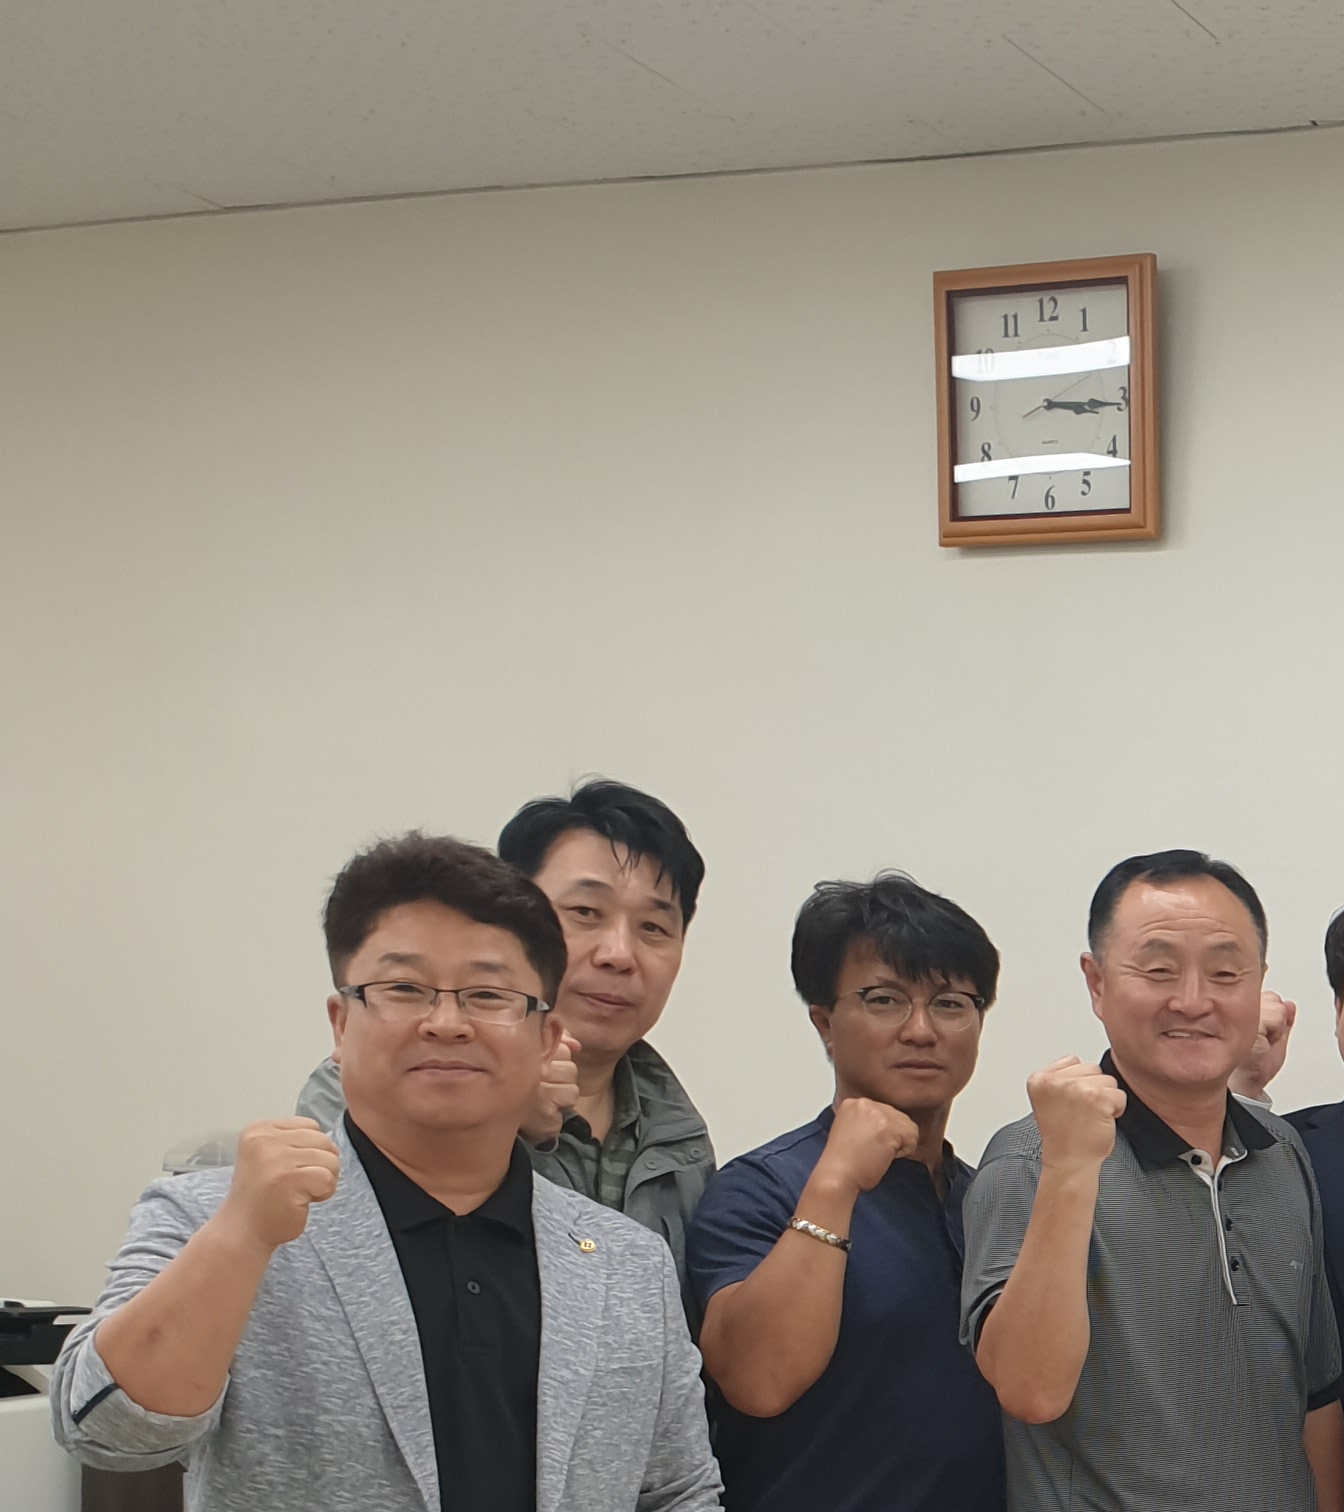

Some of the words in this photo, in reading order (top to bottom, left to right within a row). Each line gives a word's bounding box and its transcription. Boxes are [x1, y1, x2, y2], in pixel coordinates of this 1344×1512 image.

[1037, 296, 1060, 323] 12
[1080, 307, 1089, 332] 1
[1001, 313, 1020, 338] 11
[970, 396, 981, 421] 9
[1116, 386, 1129, 411] 3
[980, 442, 992, 463] 8
[1106, 434, 1118, 458] 4
[1007, 475, 1020, 500] 7
[1080, 471, 1092, 496] 5
[1044, 485, 1056, 510] 6
